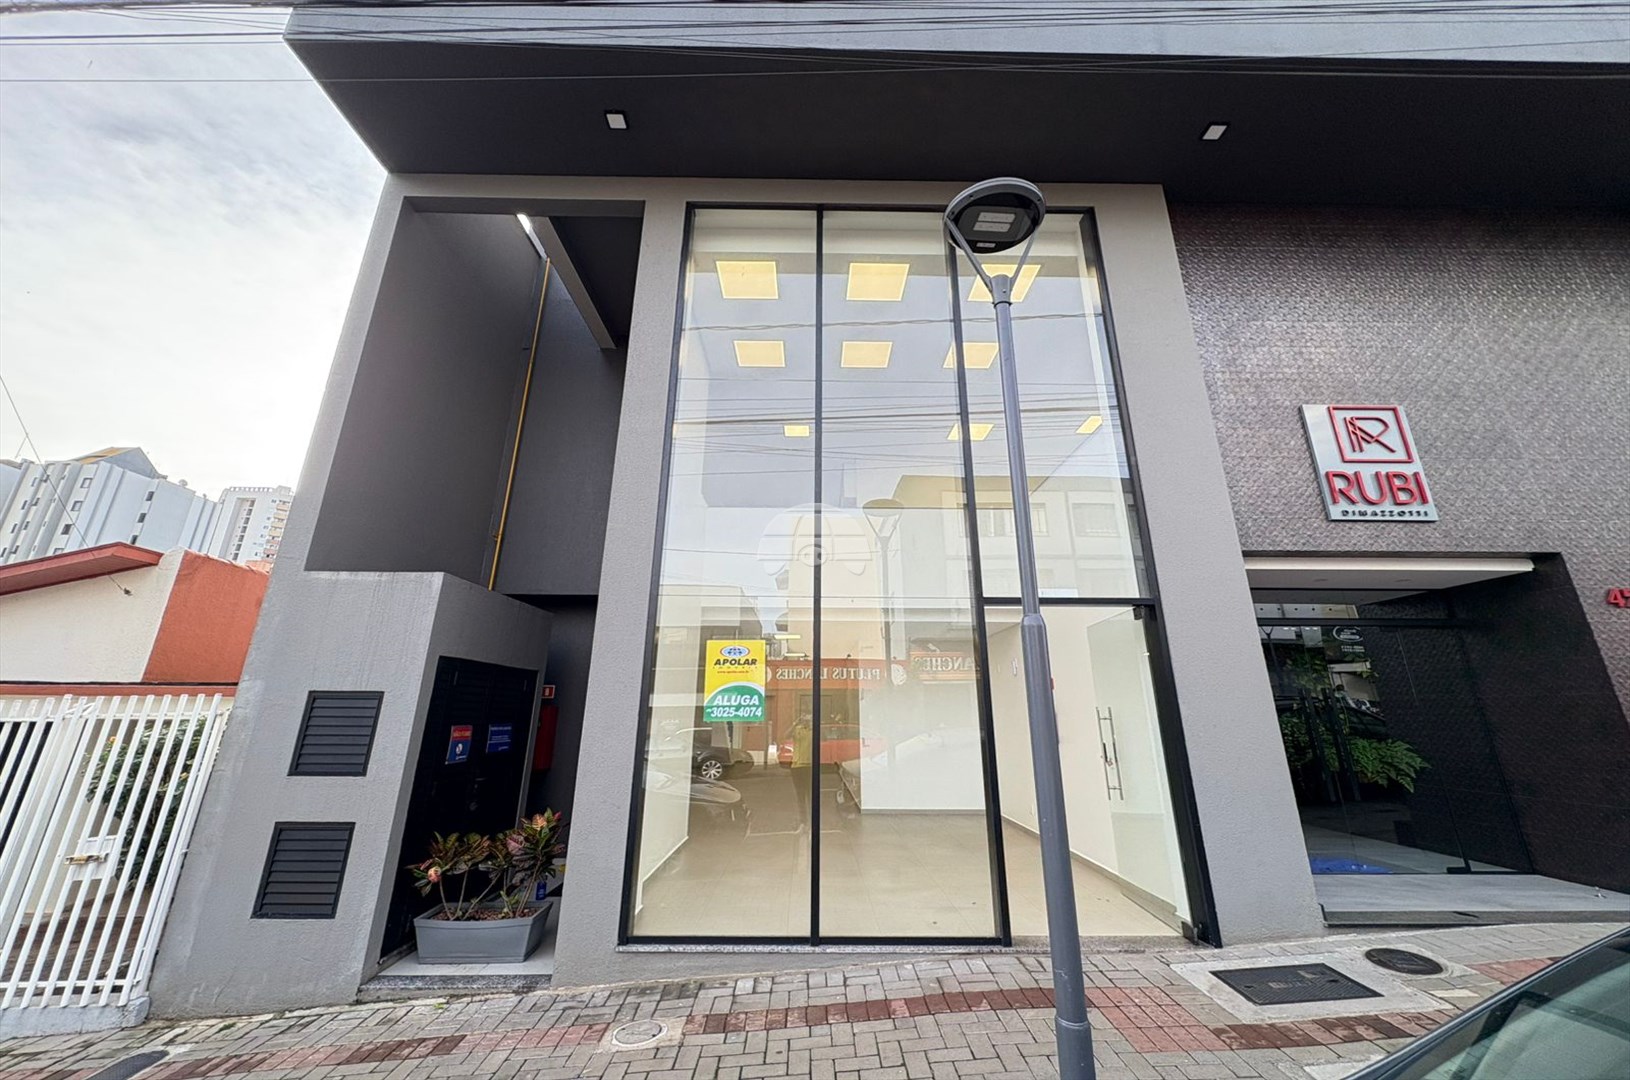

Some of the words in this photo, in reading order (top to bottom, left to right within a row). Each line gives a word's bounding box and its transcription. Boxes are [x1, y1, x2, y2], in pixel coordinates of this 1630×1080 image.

[1325, 470, 1429, 505] RUBI
[714, 658, 758, 666] APOLAR
[712, 694, 760, 706] ALUGA
[710, 706, 763, 718] 3025-4074
